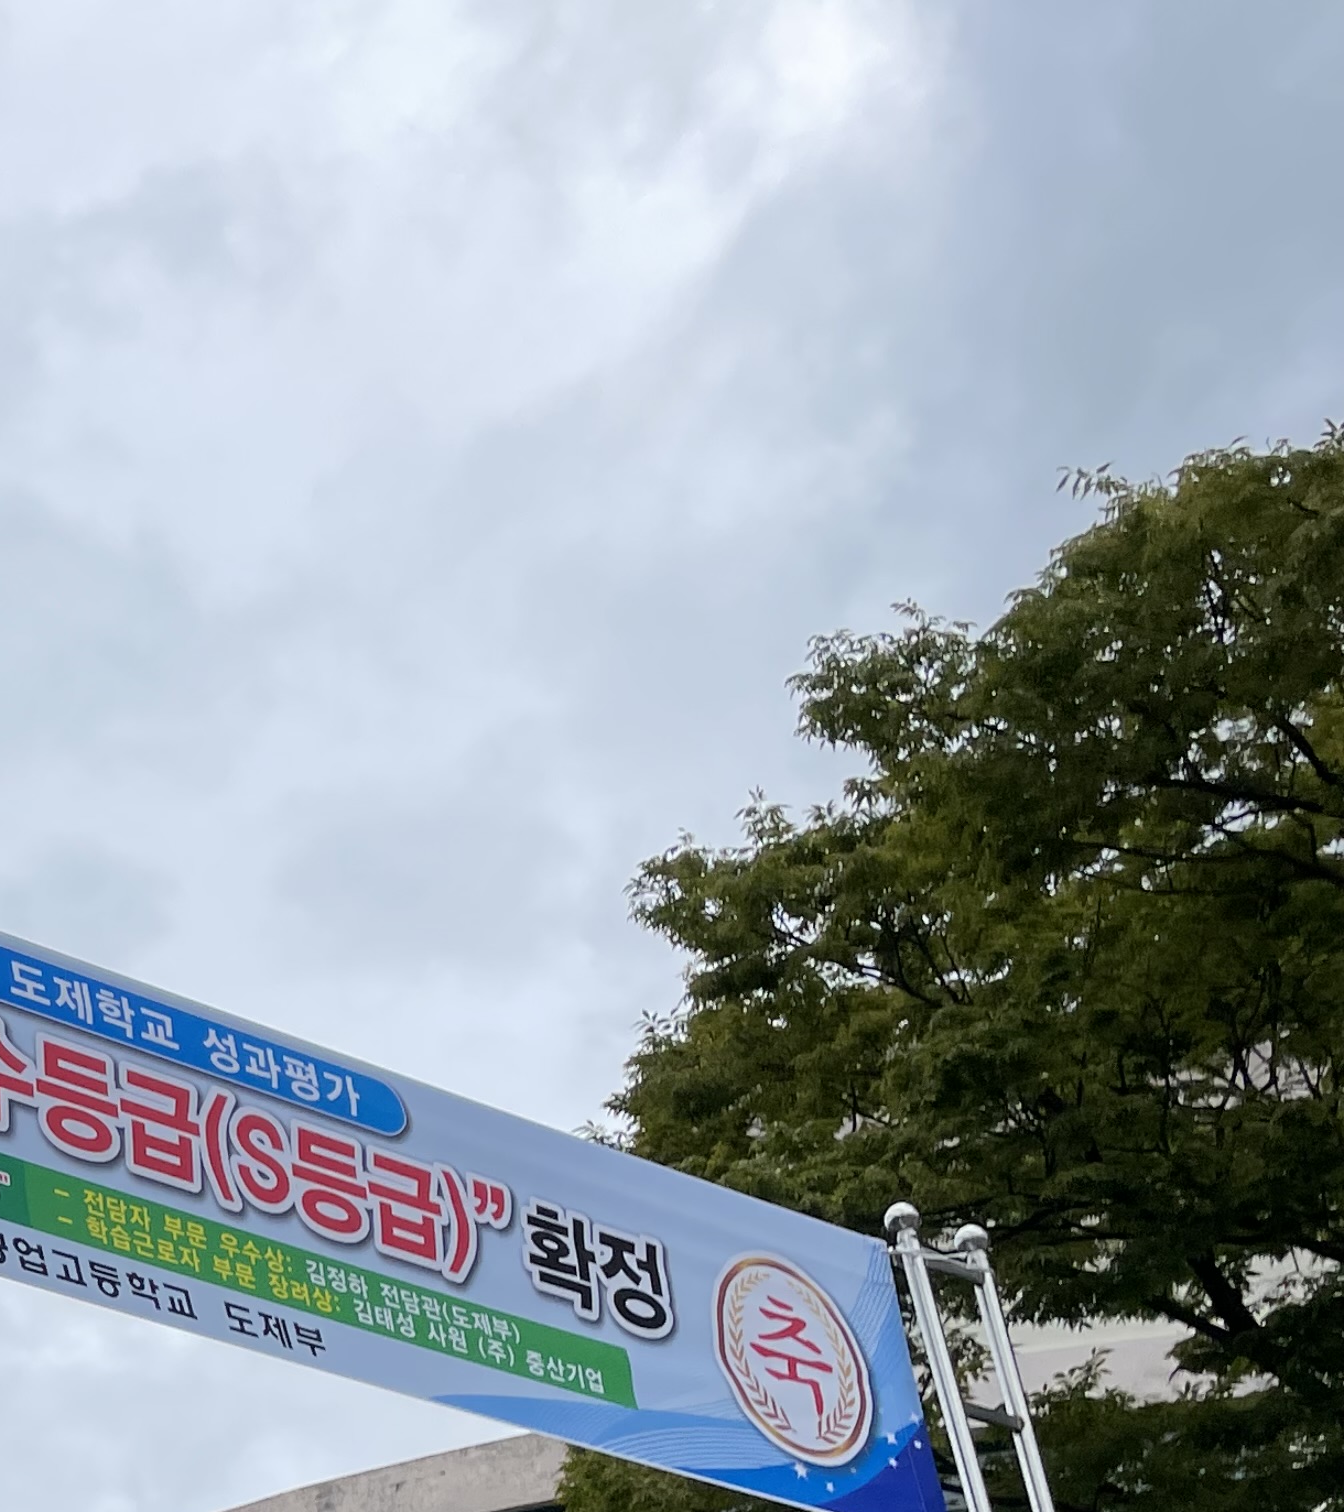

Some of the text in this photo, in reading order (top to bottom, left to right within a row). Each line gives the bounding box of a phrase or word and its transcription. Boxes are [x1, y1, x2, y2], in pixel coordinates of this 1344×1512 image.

[11, 960, 180, 1051] 도제학교
[203, 1028, 360, 1116] 성과평가
[83, 1188, 151, 1232] 전담자
[164, 1214, 207, 1250] 부문
[220, 1232, 293, 1273] 우수상:
[305, 1258, 369, 1300] 김정하
[379, 1283, 522, 1345] 전담관(도제부)
[85, 1215, 200, 1273] 학습근로자
[213, 1255, 256, 1290] 부문
[268, 1272, 341, 1314] 장려상:
[353, 1299, 417, 1338] 김태성
[427, 1321, 469, 1354] 사원
[478, 1335, 515, 1368] (주)
[223, 1300, 327, 1357] 도제부
[526, 1204, 667, 1329] 확정
[749, 1294, 833, 1423] 축
